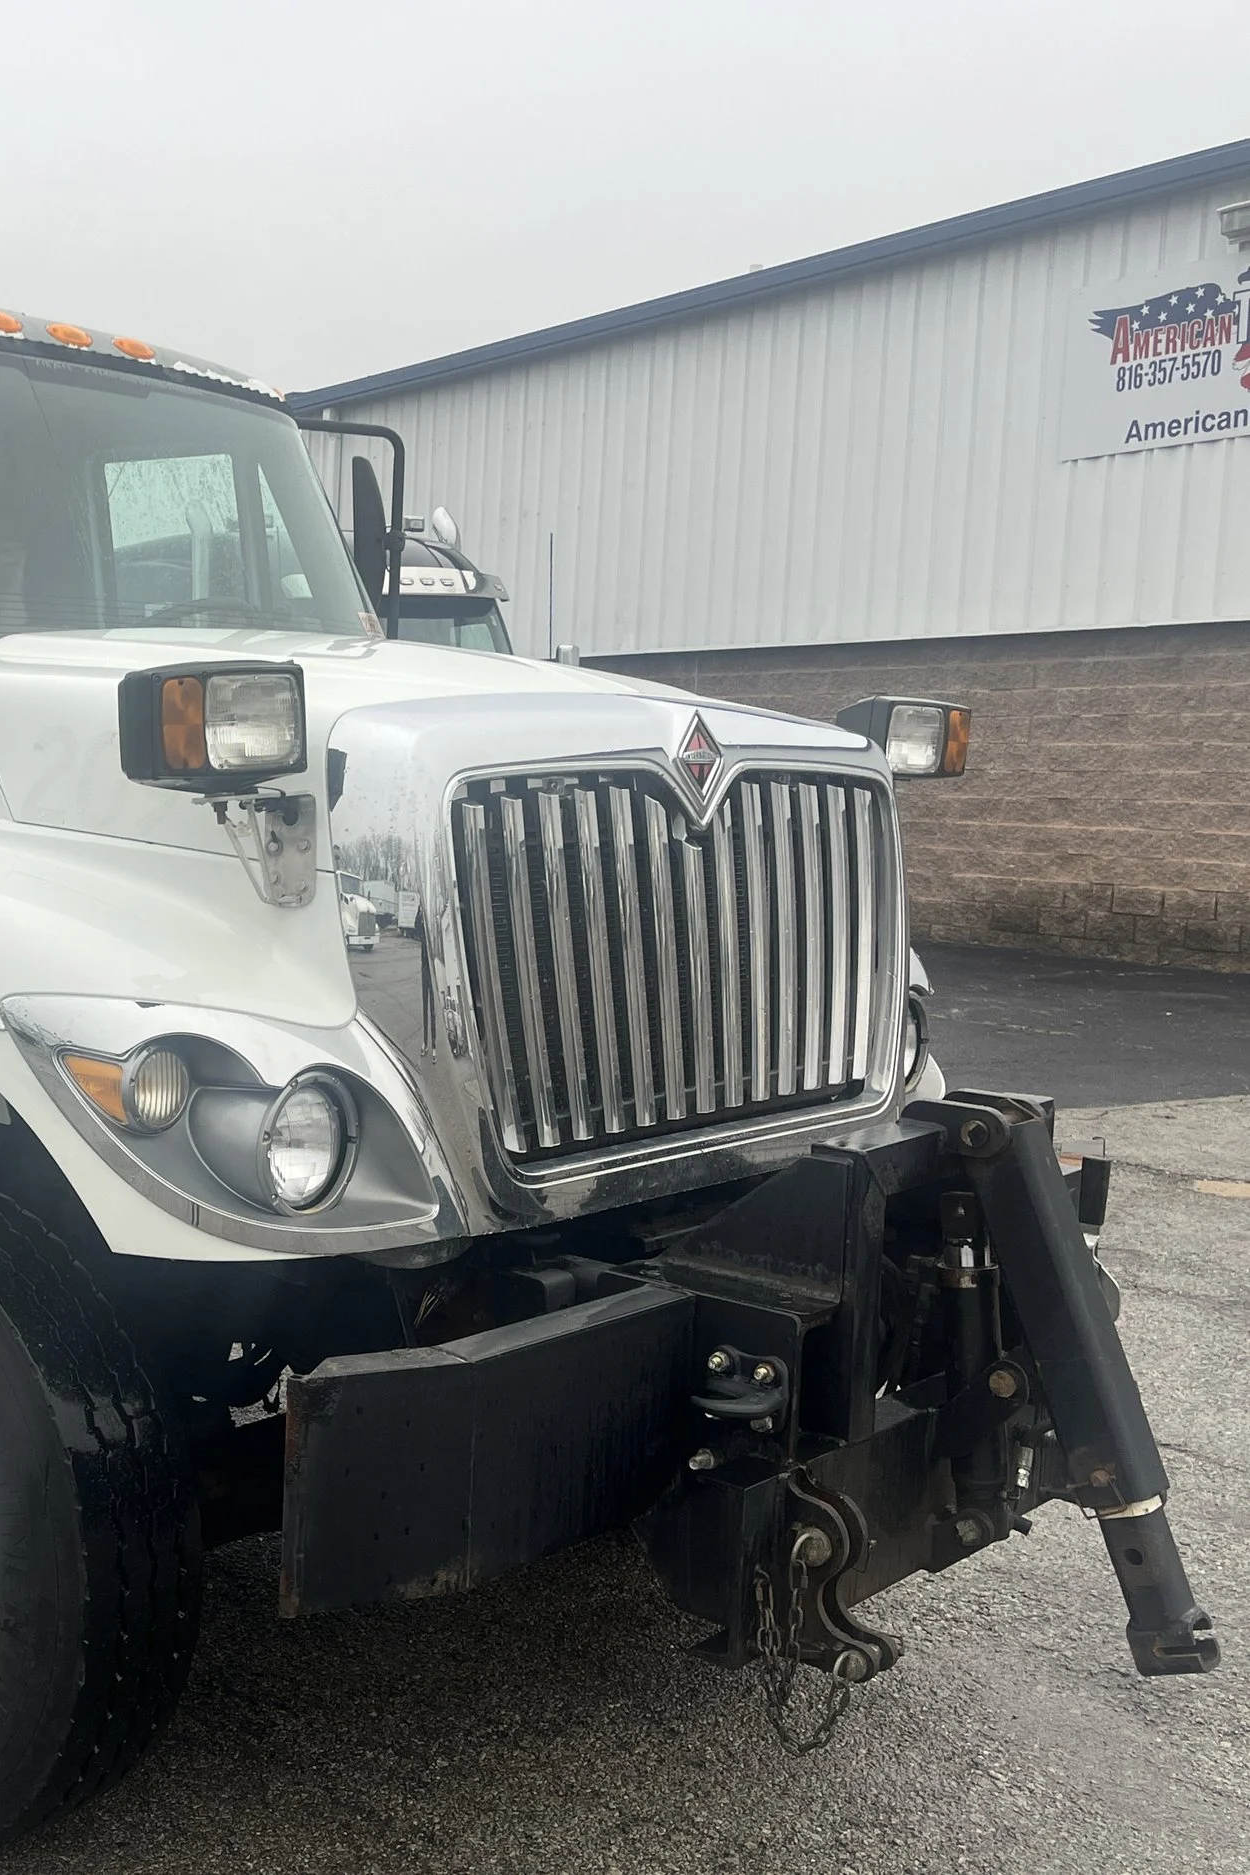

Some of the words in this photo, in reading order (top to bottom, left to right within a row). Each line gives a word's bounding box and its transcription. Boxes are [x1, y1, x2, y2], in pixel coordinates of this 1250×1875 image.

[1110, 314, 1233, 366] AMERICAN
[1116, 349, 1222, 392] 816-357-5570
[1124, 408, 1249, 444] American
